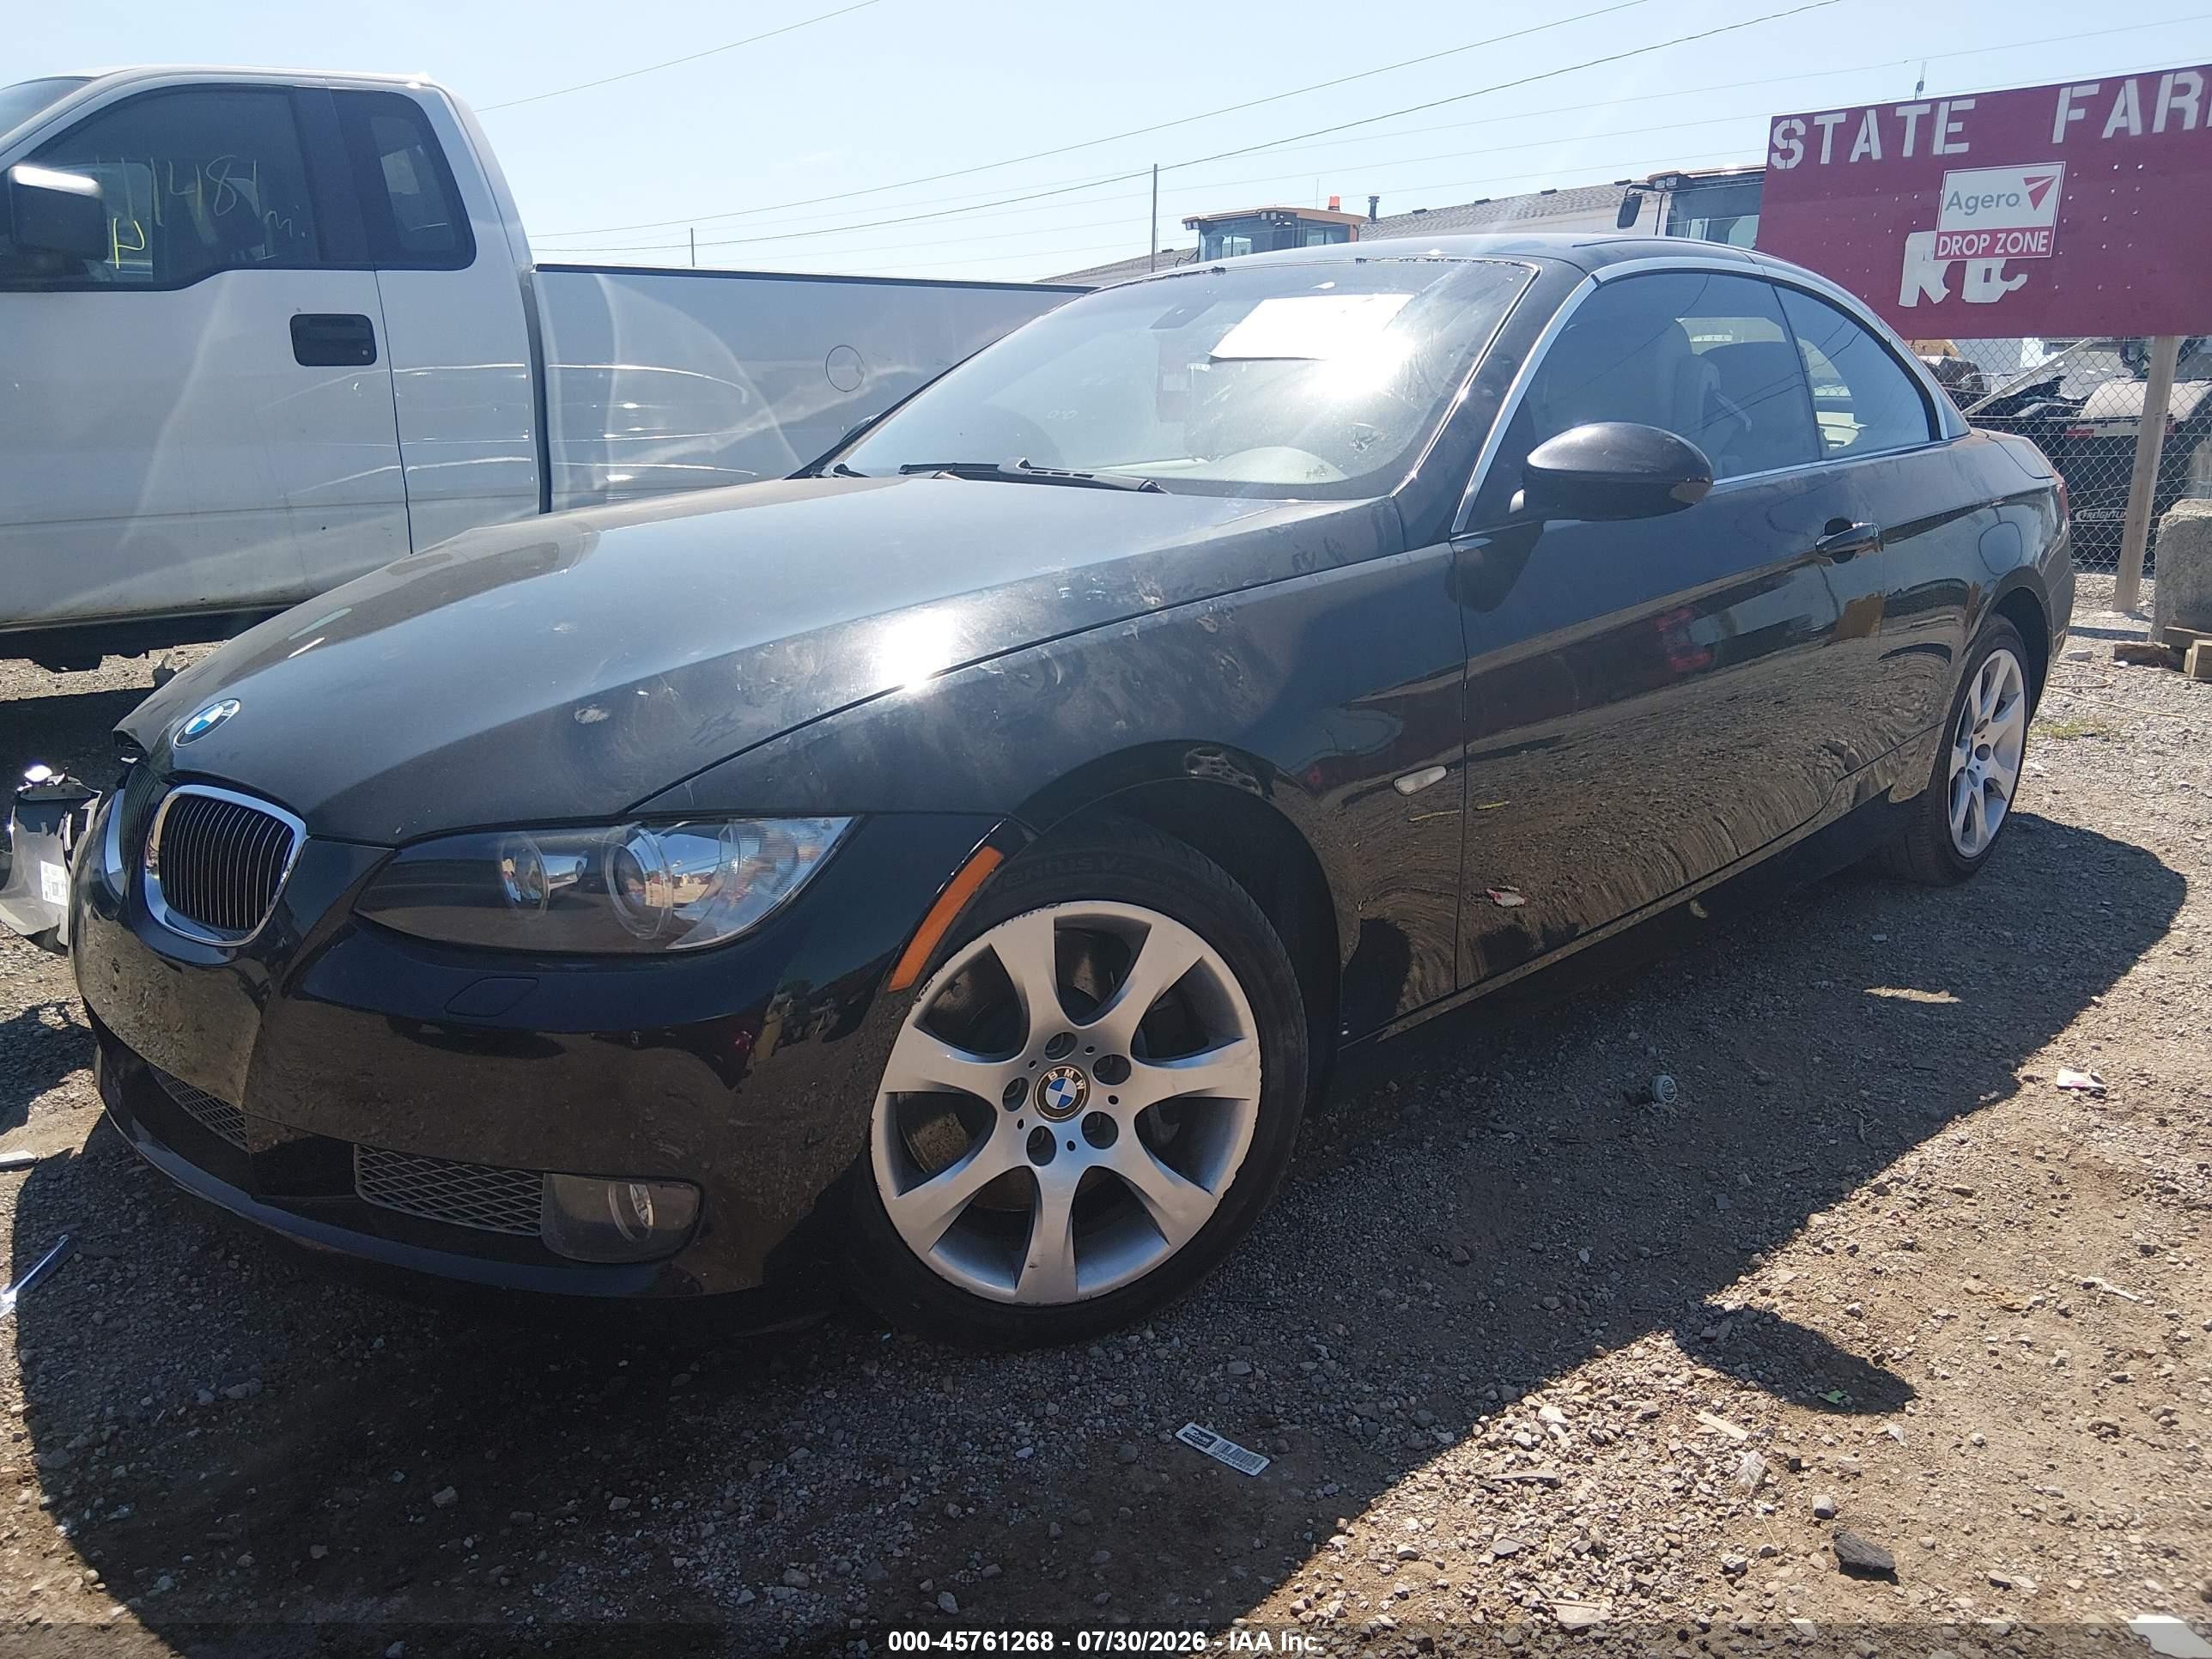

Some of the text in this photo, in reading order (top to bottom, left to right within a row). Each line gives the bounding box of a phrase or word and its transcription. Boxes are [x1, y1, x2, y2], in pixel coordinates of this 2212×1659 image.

[1771, 71, 2212, 169] STATE FAR
[1945, 191, 2021, 216] Agero
[1937, 231, 2049, 257] DROP ZONE
[1048, 1069, 1085, 1090] BMW
